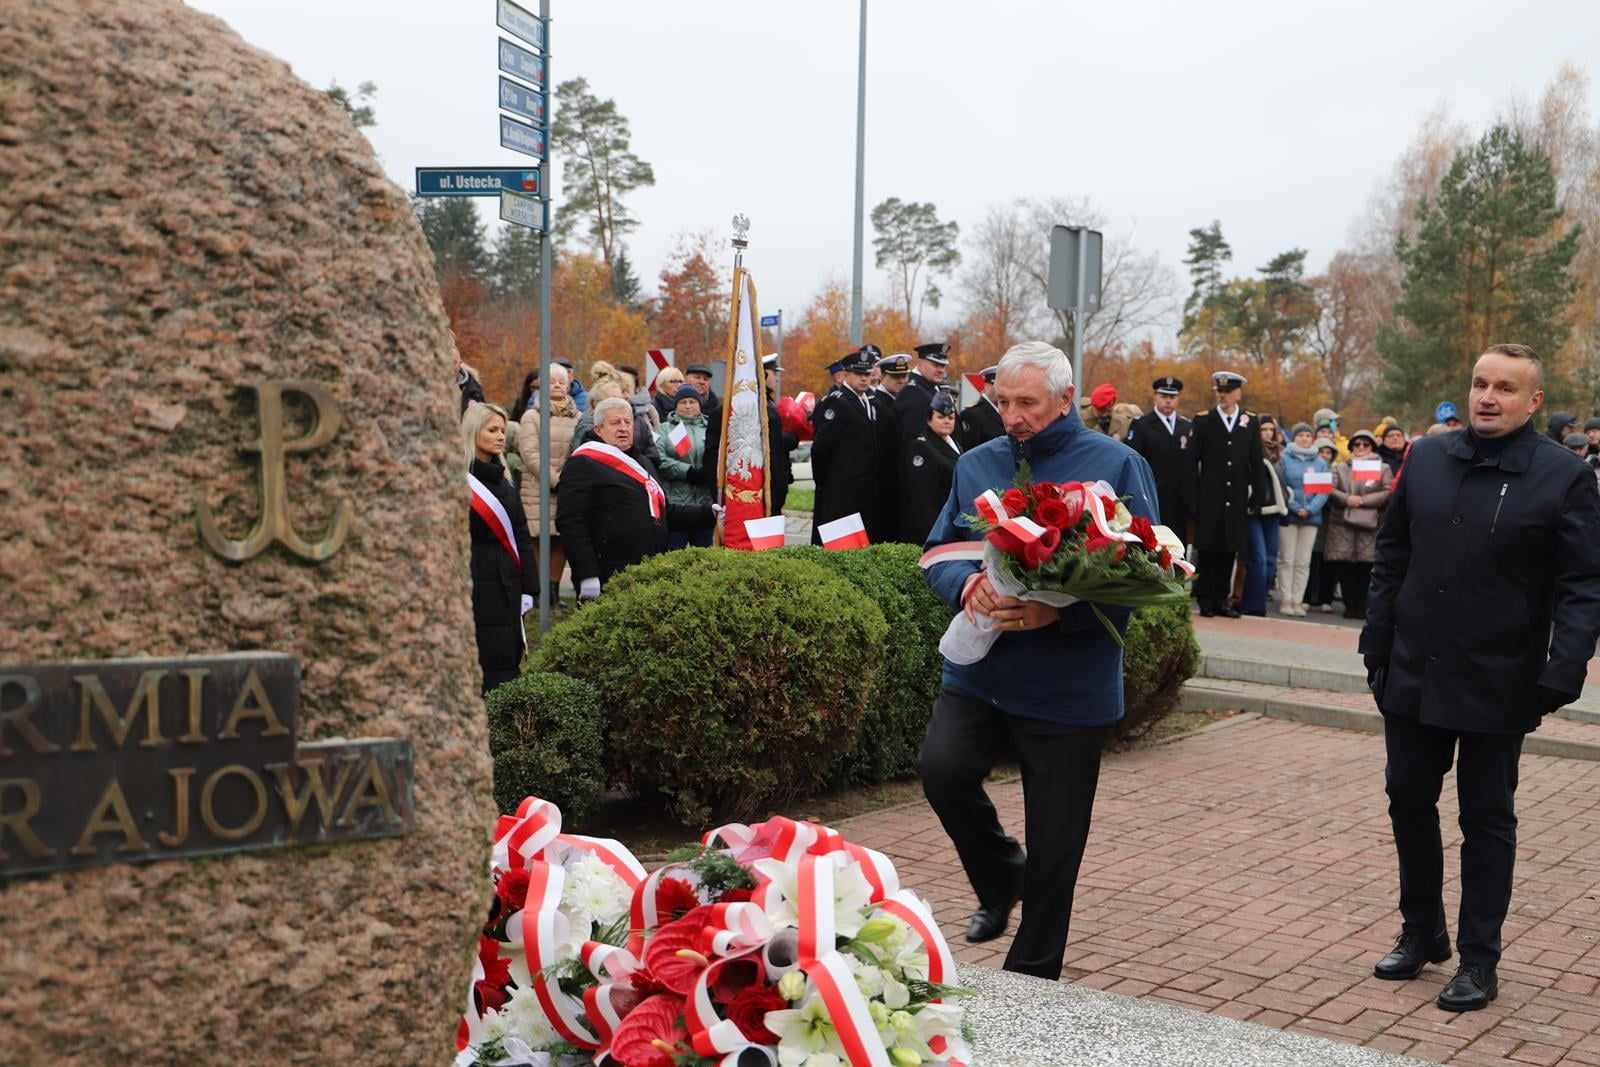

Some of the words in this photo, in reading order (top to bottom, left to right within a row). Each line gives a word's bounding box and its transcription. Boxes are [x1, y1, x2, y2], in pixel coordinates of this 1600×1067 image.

[440, 175, 454, 189] ul.
[456, 175, 502, 189] Ustecka
[0, 666, 290, 757] RMIA
